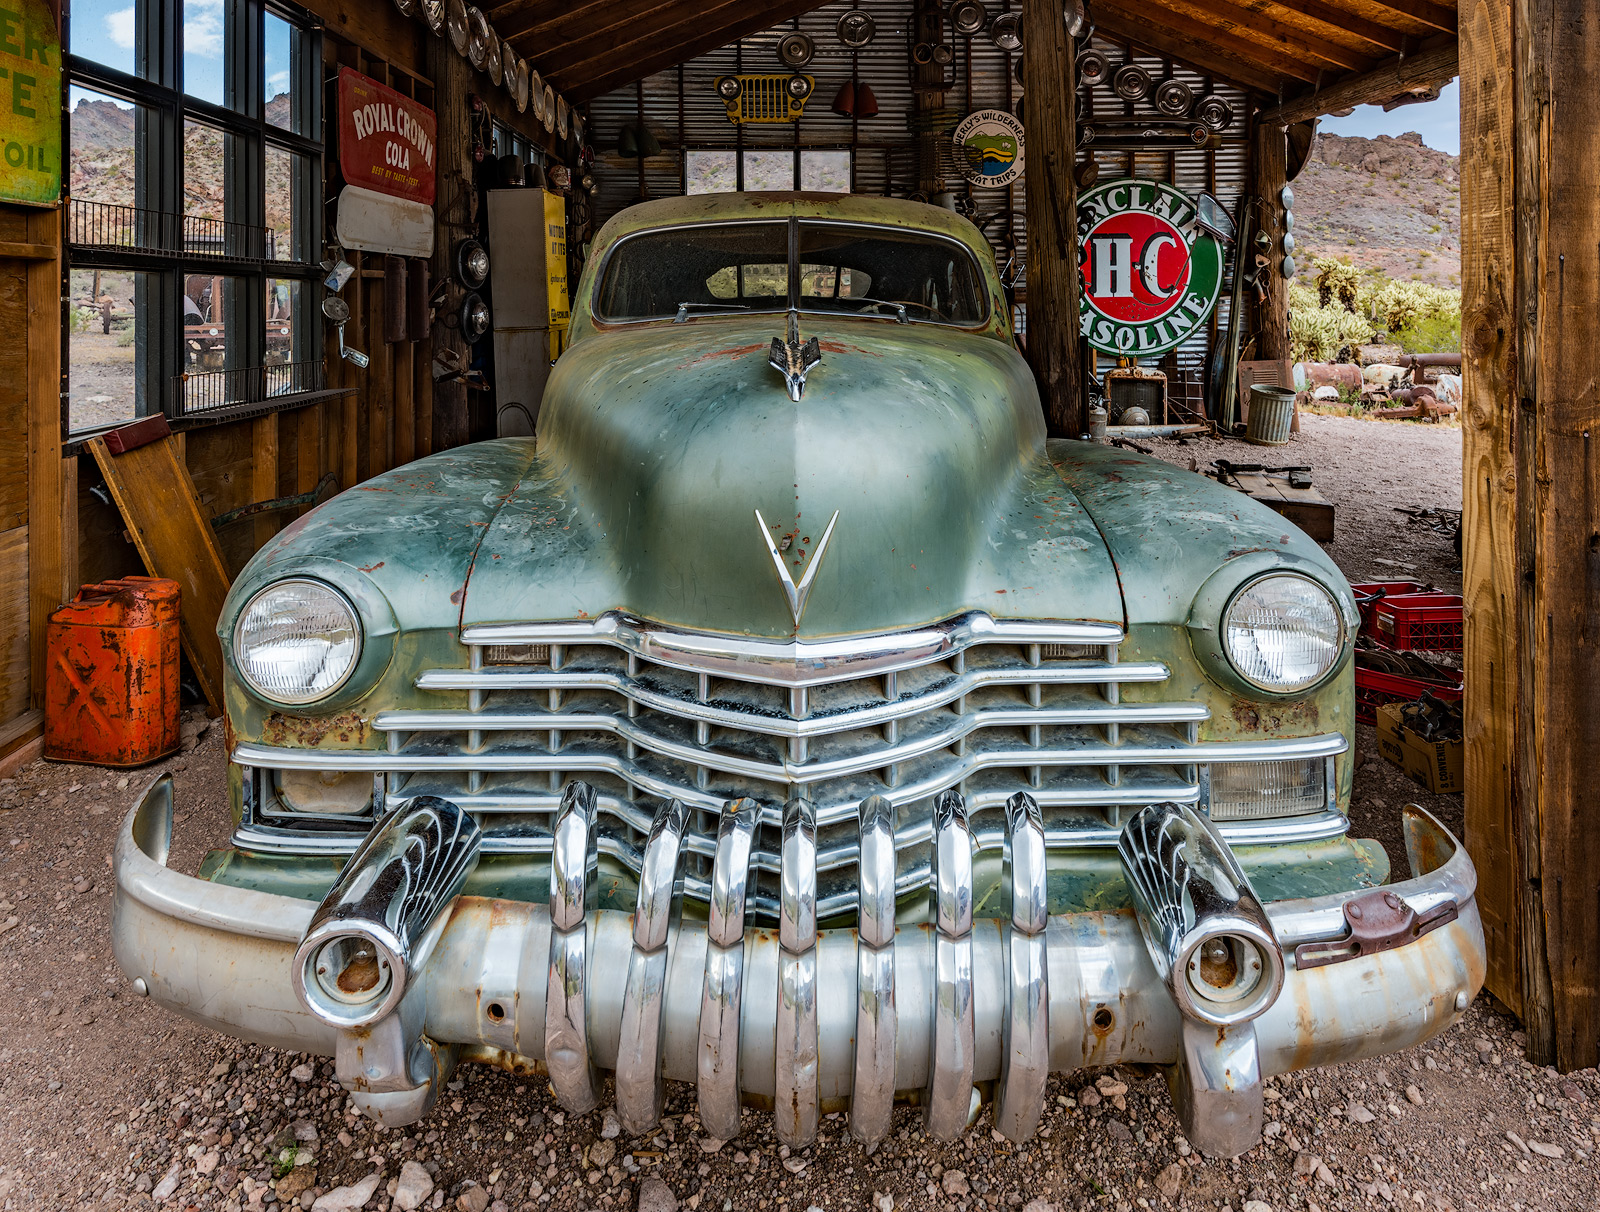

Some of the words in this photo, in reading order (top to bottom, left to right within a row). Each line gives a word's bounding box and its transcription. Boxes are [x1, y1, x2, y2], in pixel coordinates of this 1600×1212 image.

[0, 67, 36, 119] E
[352, 103, 396, 141] ROYAL
[396, 107, 433, 167] CROWN
[981, 112, 1025, 147] WILDERNESS
[4, 141, 51, 174] OIL
[371, 165, 384, 176] BEST
[384, 169, 392, 178] BY
[385, 140, 410, 171] COLA
[965, 171, 988, 186] OAT
[990, 168, 1017, 186] TRIPS
[1077, 186, 1205, 247] NCLAIR
[1079, 292, 1209, 351] ASOLINE
